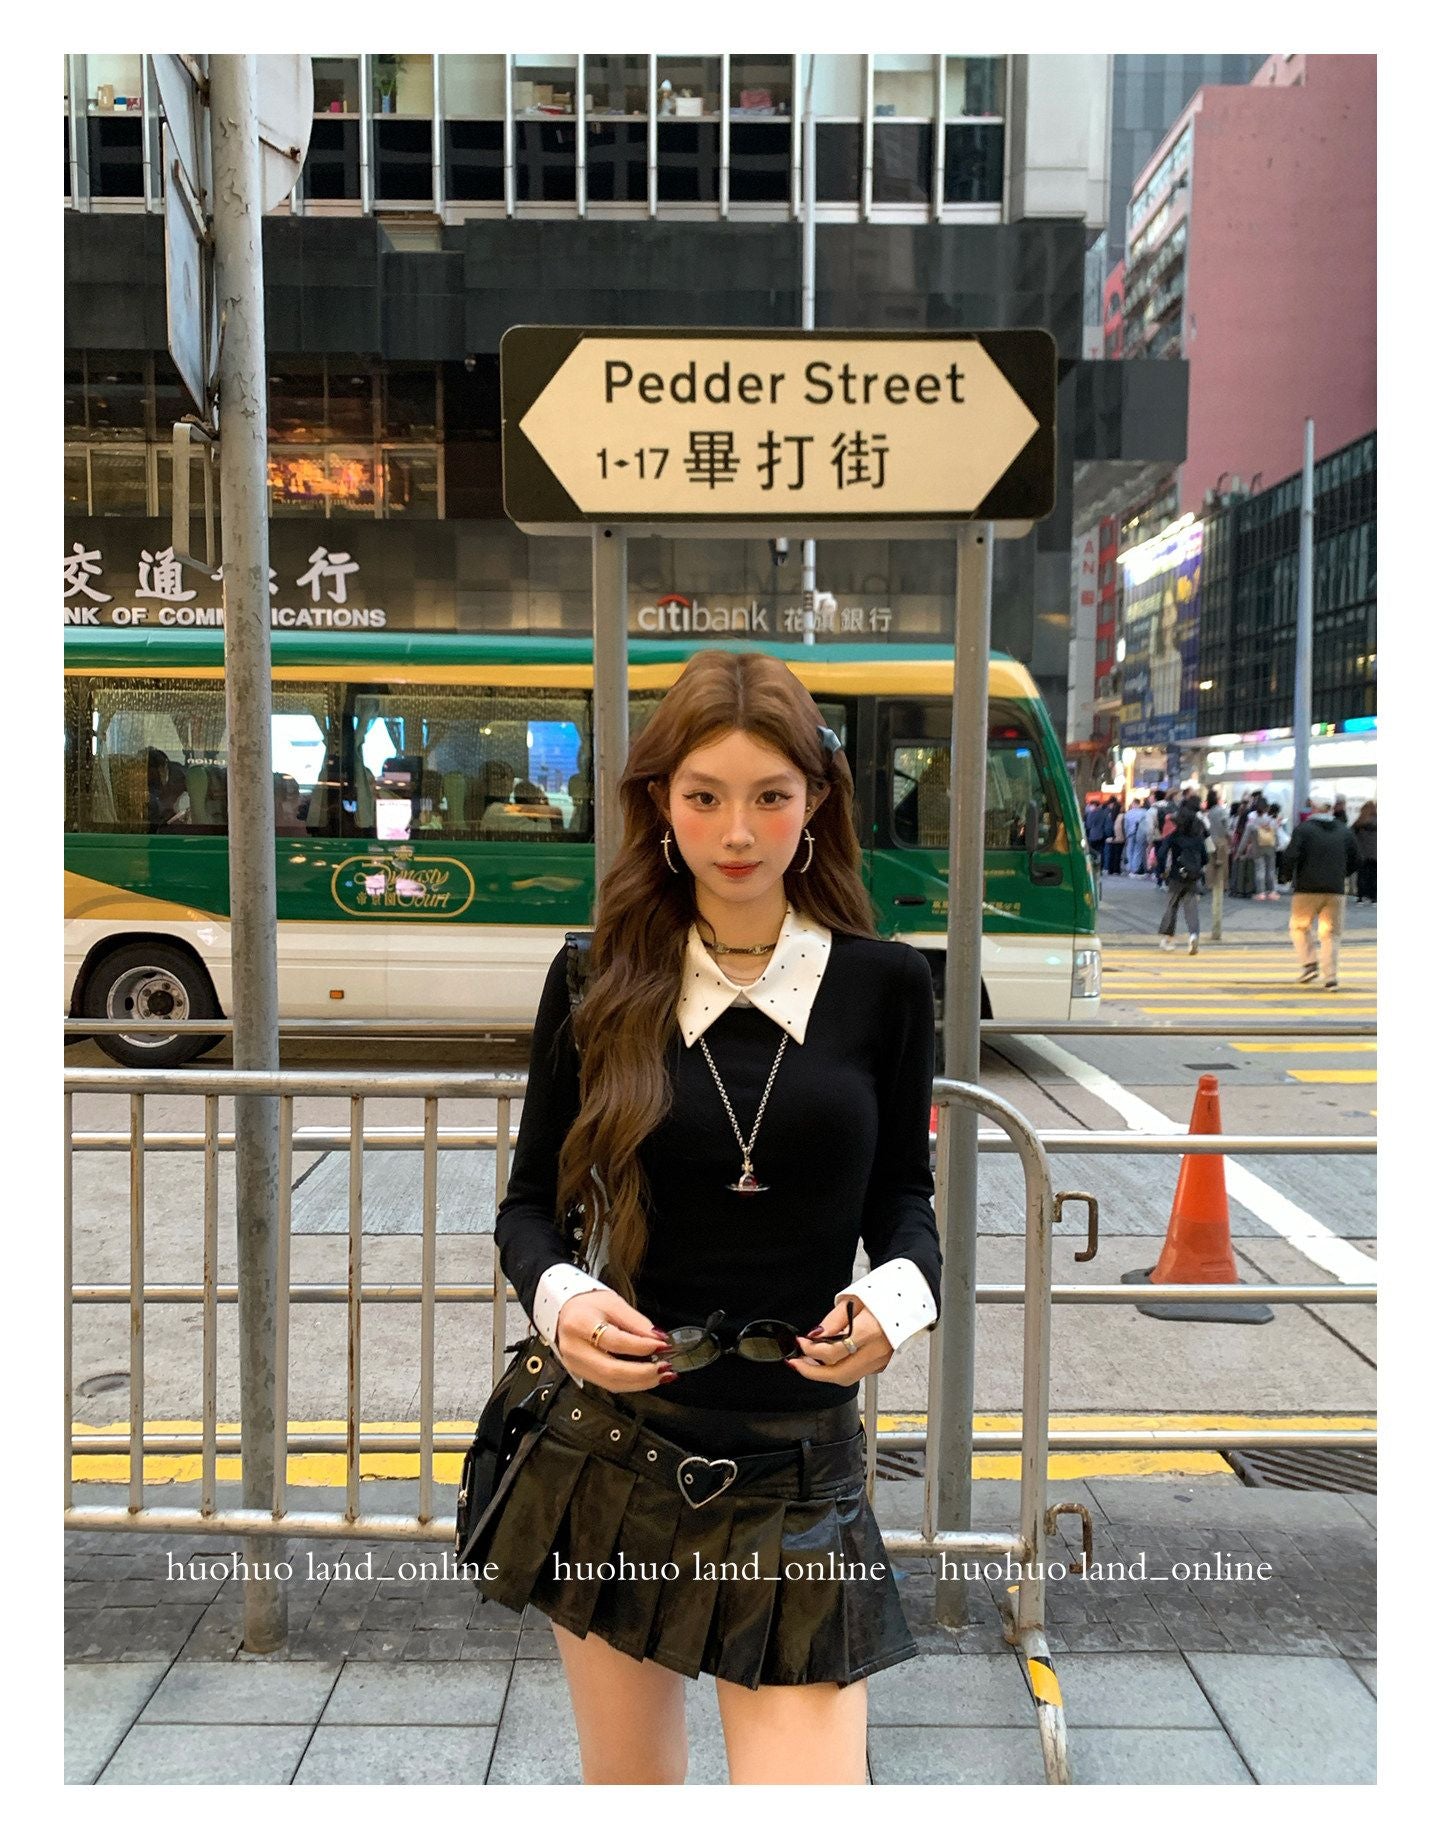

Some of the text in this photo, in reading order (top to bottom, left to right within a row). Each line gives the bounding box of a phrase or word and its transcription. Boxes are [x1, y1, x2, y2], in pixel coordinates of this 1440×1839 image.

[603, 359, 967, 406] Pedder Street
[683, 430, 891, 491] 畢打街
[64, 542, 360, 604] 交通行
[64, 606, 387, 627] NK OF COMICATIONS
[637, 596, 769, 633] citibank
